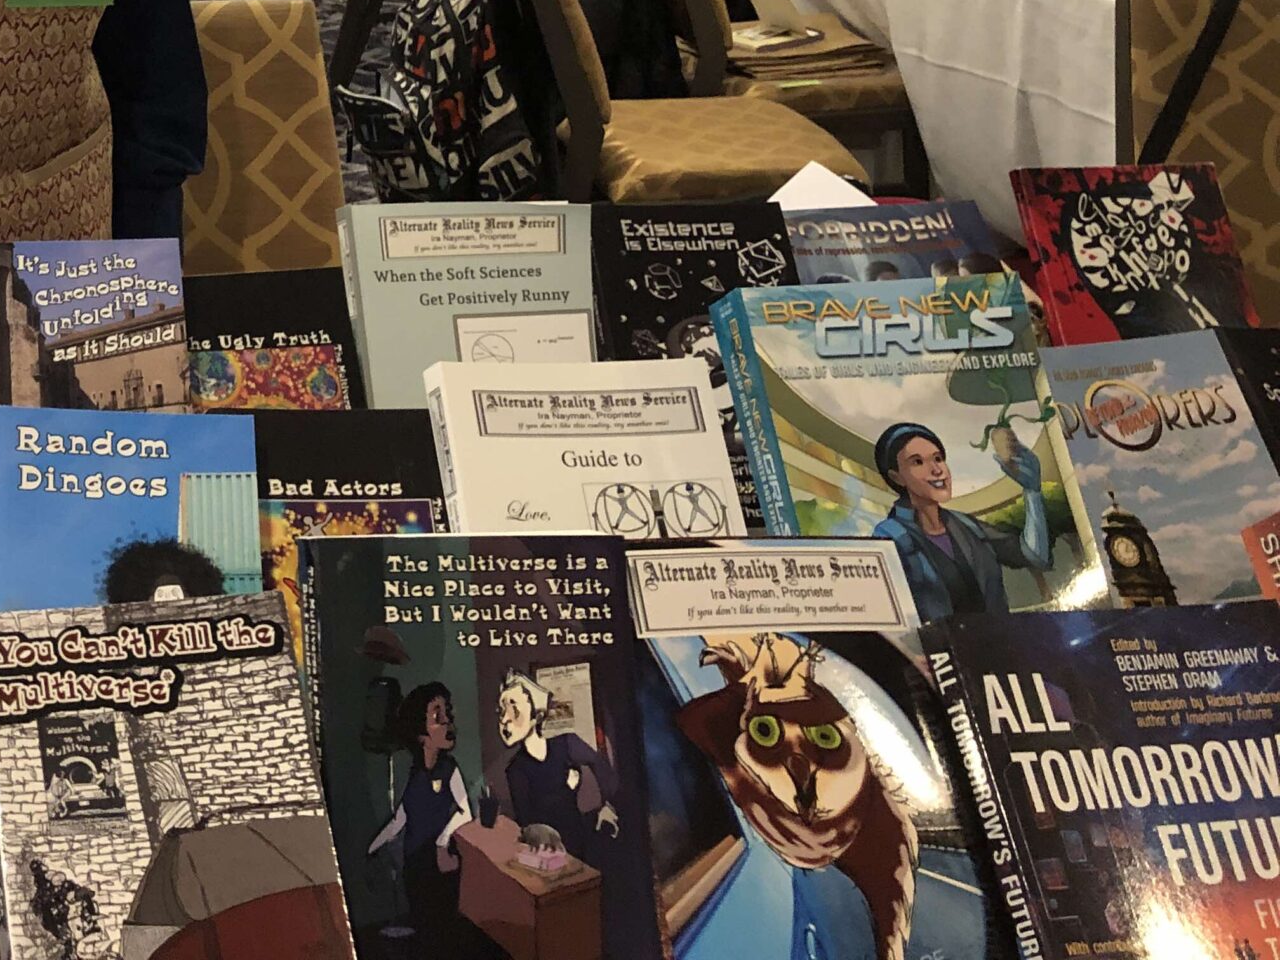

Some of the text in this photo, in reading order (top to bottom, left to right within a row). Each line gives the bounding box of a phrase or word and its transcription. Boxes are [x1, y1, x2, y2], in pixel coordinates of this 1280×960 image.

[389, 216, 556, 237] Alternate Reality News Service
[620, 218, 736, 238] Existence
[624, 235, 740, 252] is Elsewhen
[15, 251, 137, 279] It's Just the
[373, 265, 542, 283] When the Soft Sciences
[34, 275, 180, 307] Chronosphere
[419, 289, 570, 307] Get Positively Runny
[42, 290, 149, 337] Unfolding
[761, 296, 891, 325] BRAVE
[898, 289, 992, 317] NEW
[52, 323, 177, 363] as it Should
[217, 334, 265, 350] Ugly
[272, 329, 333, 347] Truth
[814, 305, 1014, 360] GIRLS
[814, 365, 827, 379] OF
[830, 363, 865, 379] GIRLS
[868, 362, 893, 378] WHO
[956, 355, 980, 371] AND
[981, 351, 1038, 369] EXPLORE
[486, 392, 688, 413] Alternate Reality News Service
[537, 412, 550, 420] Ira
[15, 425, 170, 459] Random
[561, 450, 643, 469] Guide to
[18, 464, 169, 500] Dingoes
[268, 478, 403, 497] Bad Actors
[504, 499, 552, 523] Love,
[385, 553, 609, 573] The Multiverse is a
[643, 556, 880, 590] Alternate Reality News Service
[383, 577, 612, 598] Nice Place to Visit,
[710, 589, 727, 600] Ira
[728, 587, 780, 601] Nayman,
[383, 602, 613, 624] But I Wouldn't Want
[687, 608, 696, 621] If
[697, 608, 714, 619] you
[715, 605, 738, 616] don't
[740, 604, 755, 614] like
[755, 604, 772, 614] this
[773, 604, 803, 617] reality,
[803, 605, 817, 615] try
[818, 603, 849, 614] another
[58, 627, 145, 663] Can't
[147, 622, 216, 655] Kill
[220, 618, 276, 649] the
[456, 627, 615, 648] to Live There
[1110, 638, 1158, 653] Edited by
[1116, 645, 1280, 672] BENJAMIN GREENAWAY &
[1122, 670, 1222, 693] STEPHEN ORAM
[982, 672, 1072, 735] ALL
[1130, 697, 1187, 712] Introduction
[1189, 696, 1205, 711] by
[1206, 693, 1243, 707] Richard
[1136, 707, 1273, 728] author of Imaginary Futures
[76, 733, 92, 742] the
[929, 651, 949, 696] ALL
[946, 698, 1013, 867] TOMORROW'S
